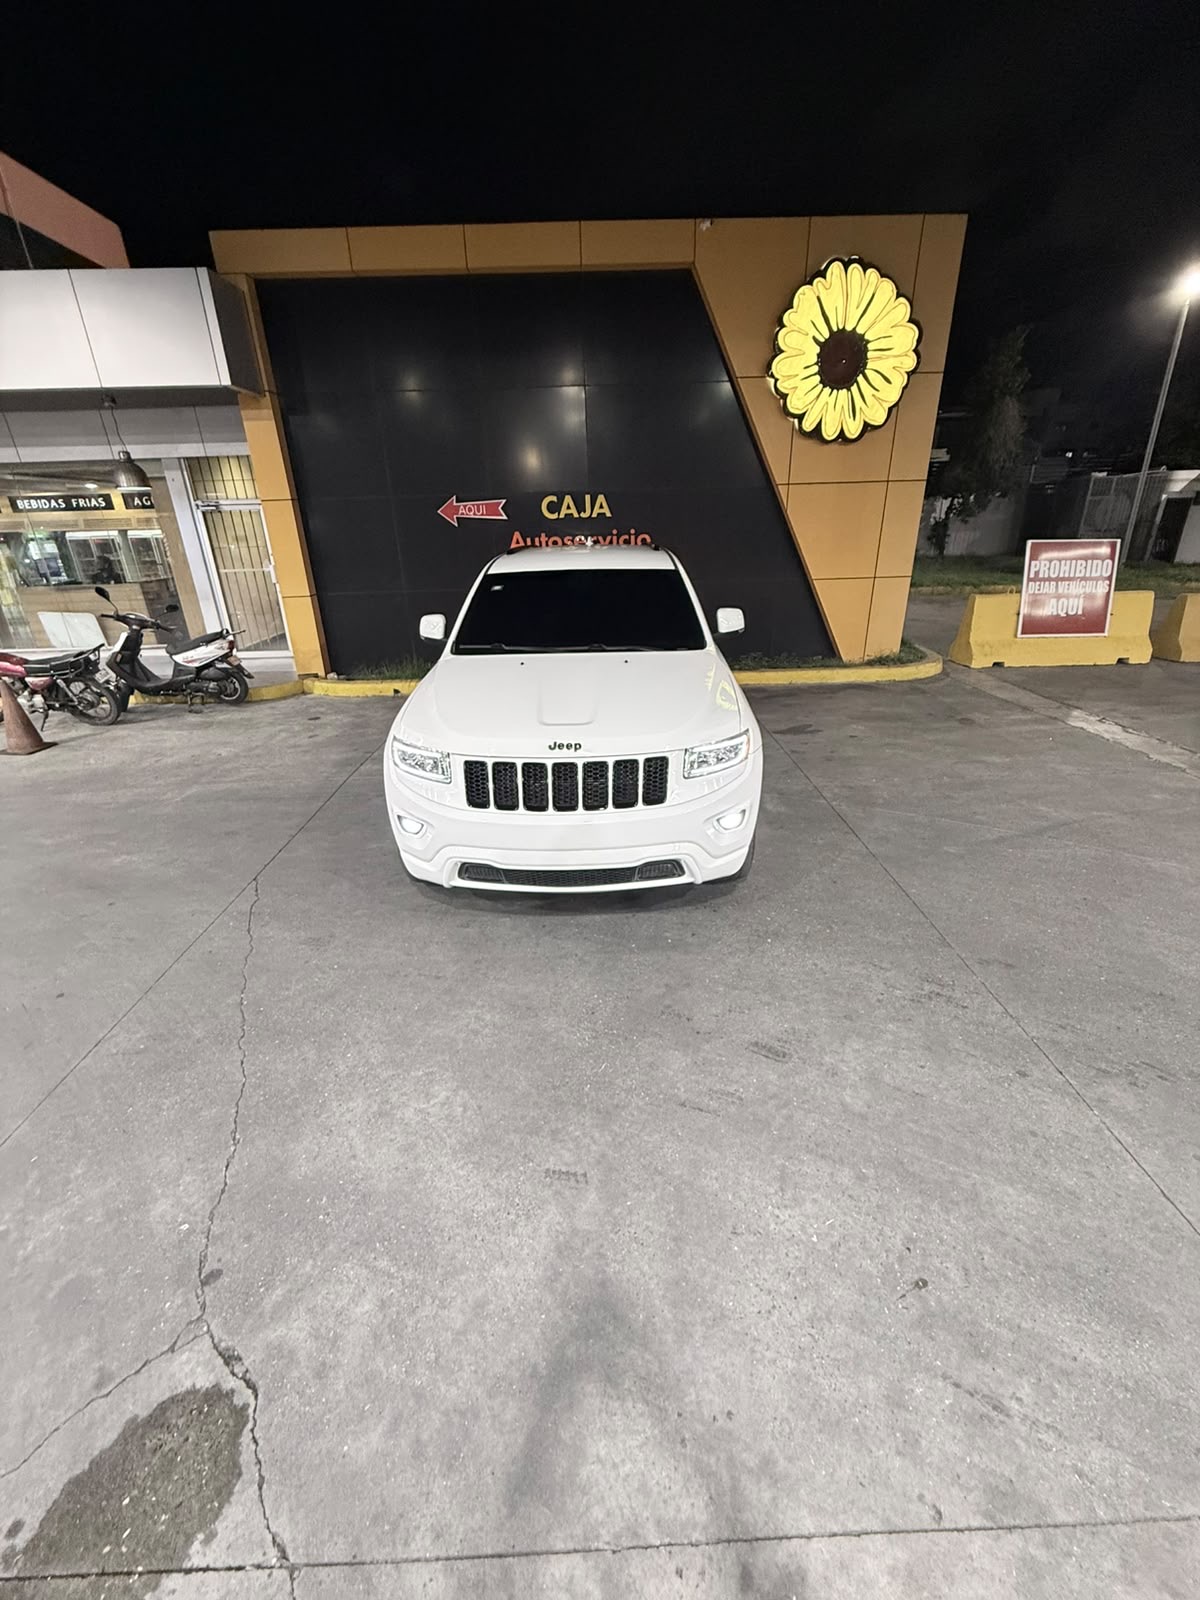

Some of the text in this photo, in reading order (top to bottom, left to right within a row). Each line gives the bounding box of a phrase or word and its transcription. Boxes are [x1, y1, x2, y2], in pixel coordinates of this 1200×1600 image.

[16, 497, 106, 510] BEBIDAS FRIAS
[134, 496, 155, 506] AG
[541, 494, 612, 520] CAJA
[458, 504, 487, 516] AQUI
[1029, 559, 1113, 578] PROHIBIDO
[1028, 579, 1110, 594] DEJAR VEHÍCULOS
[1049, 595, 1084, 617] AQUÍ
[548, 741, 582, 752] Jeep
